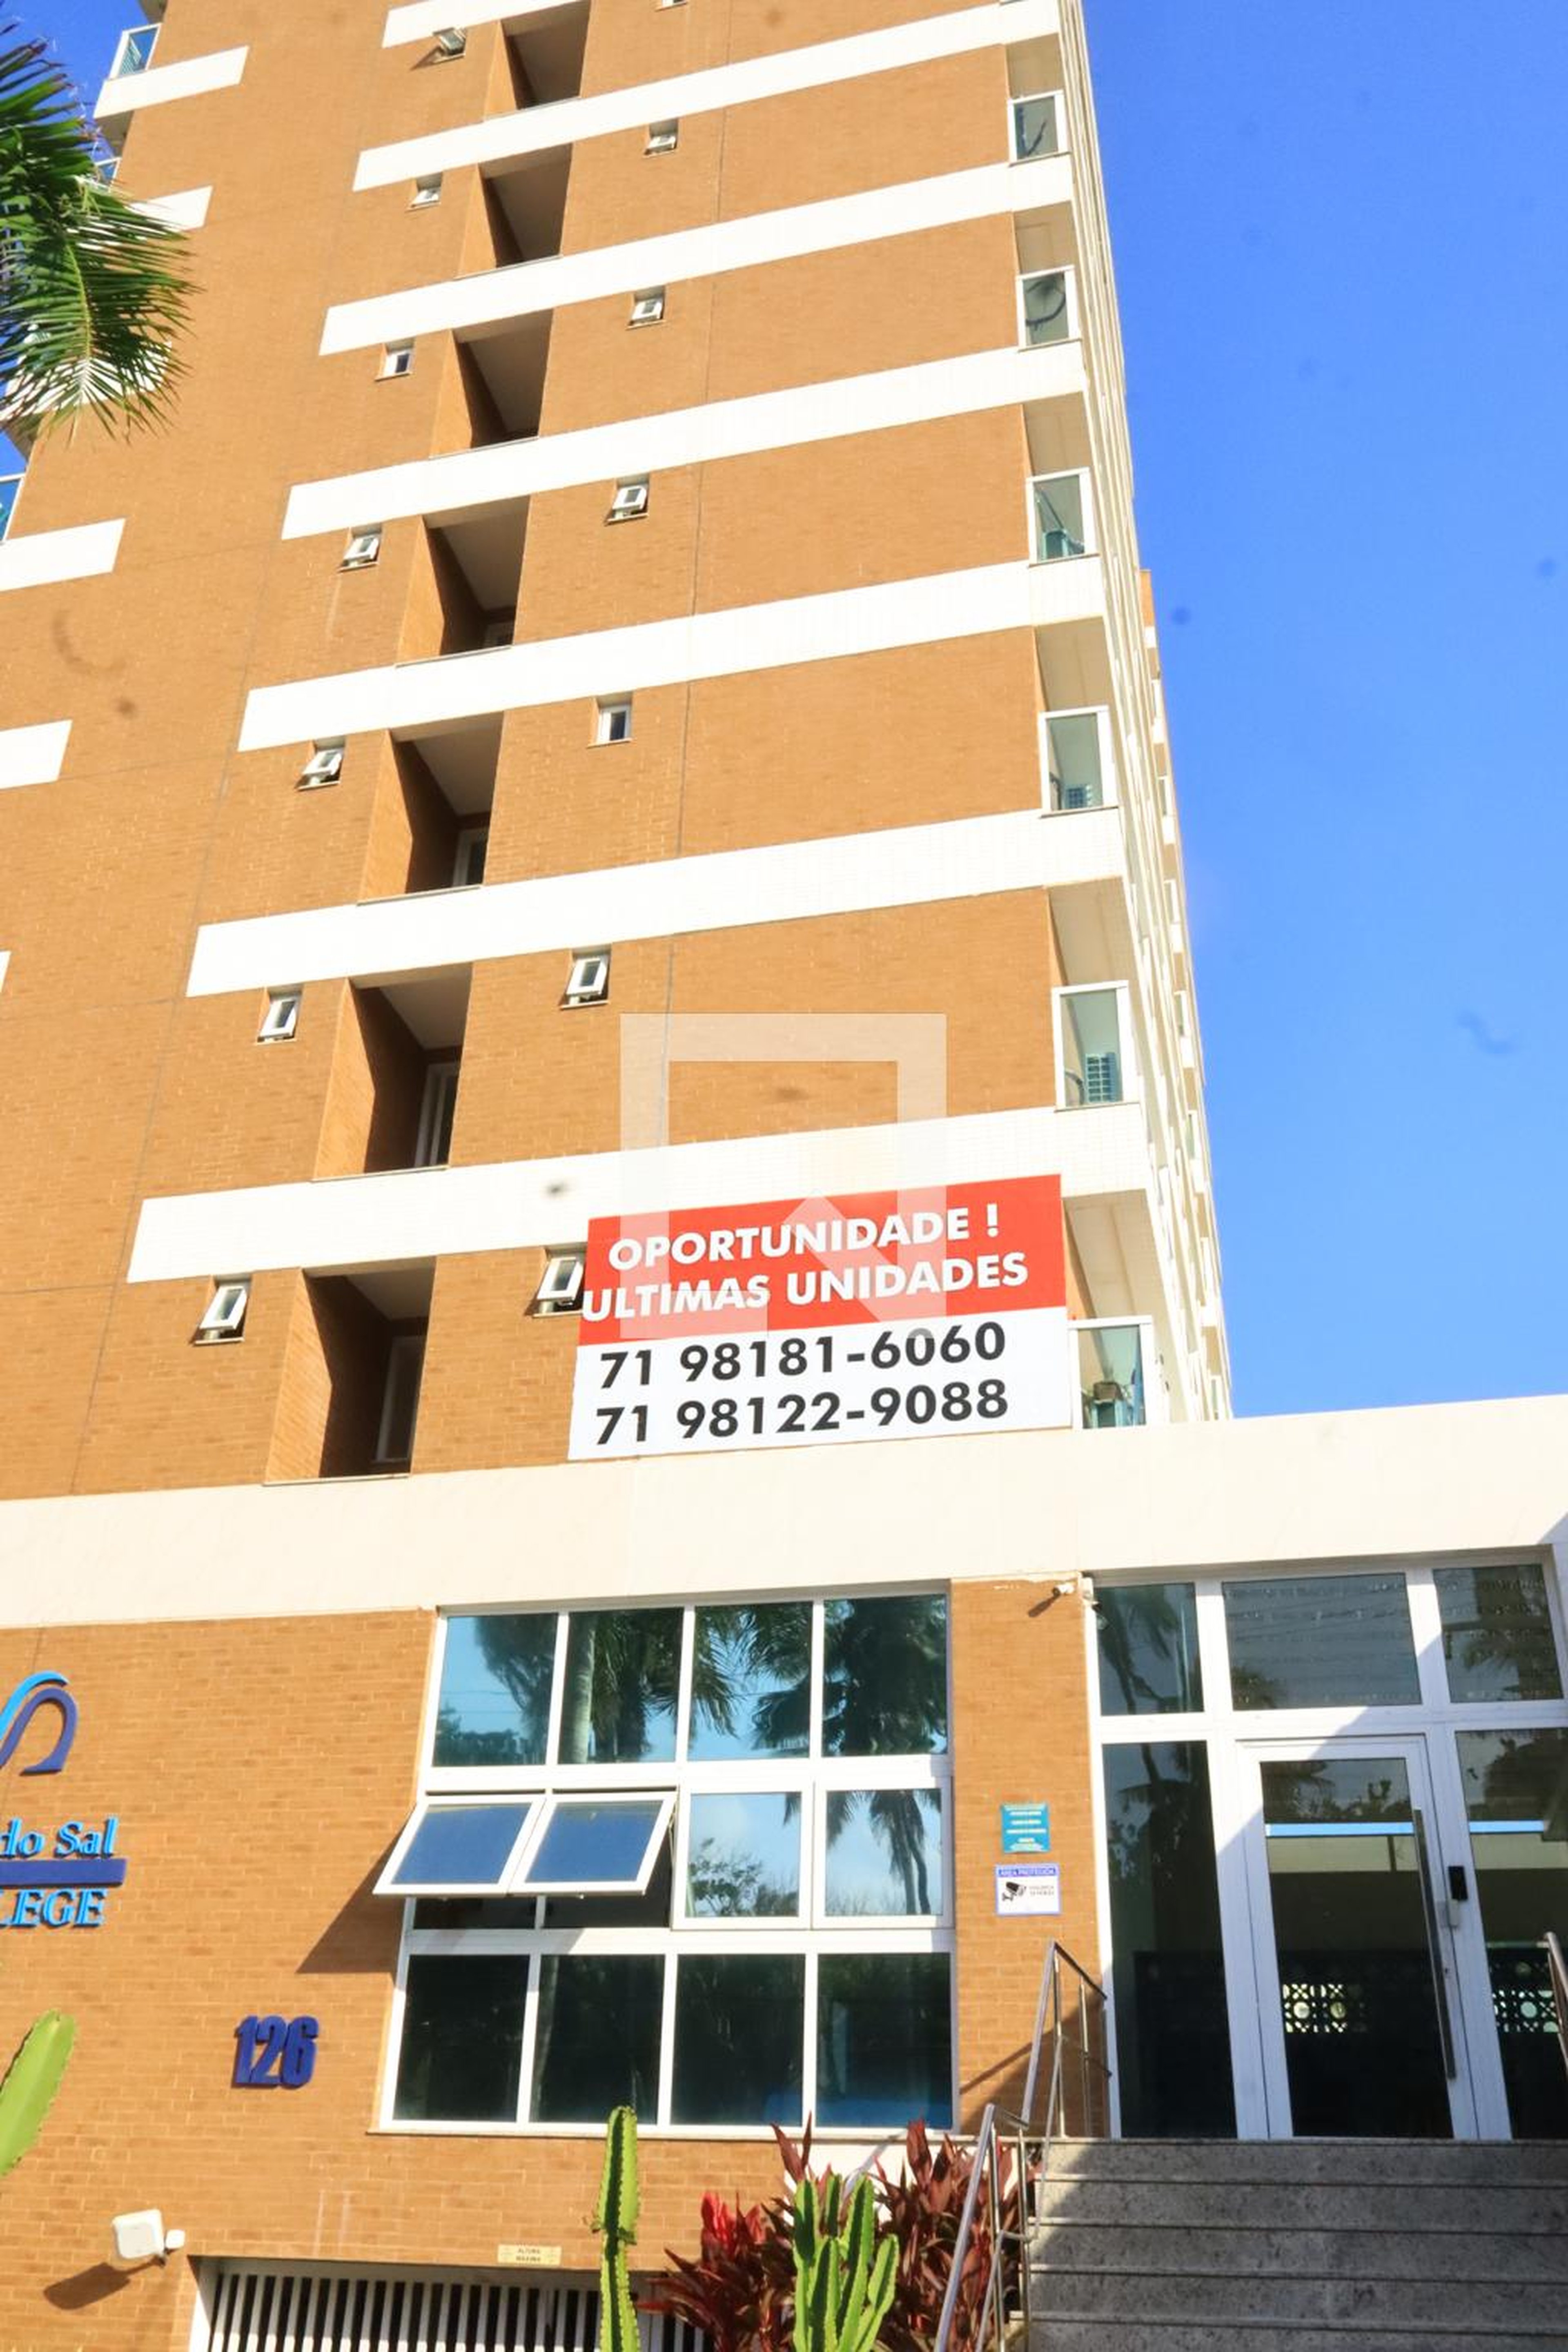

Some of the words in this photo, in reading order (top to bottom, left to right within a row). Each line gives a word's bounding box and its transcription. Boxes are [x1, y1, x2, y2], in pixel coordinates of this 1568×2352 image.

[608, 1207, 970, 1271] OPORTUNIDADE
[987, 1203, 999, 1238] !
[582, 1274, 771, 1321] ULTIMAS
[787, 1252, 1028, 1305] UNIDADES
[600, 1350, 652, 1389] 71
[679, 1321, 1005, 1382] 98181-6060
[596, 1405, 648, 1445] 71
[676, 1379, 1008, 1439] 98122-9088
[54, 1817, 118, 1858] Sal
[232, 2015, 320, 2090] 126
